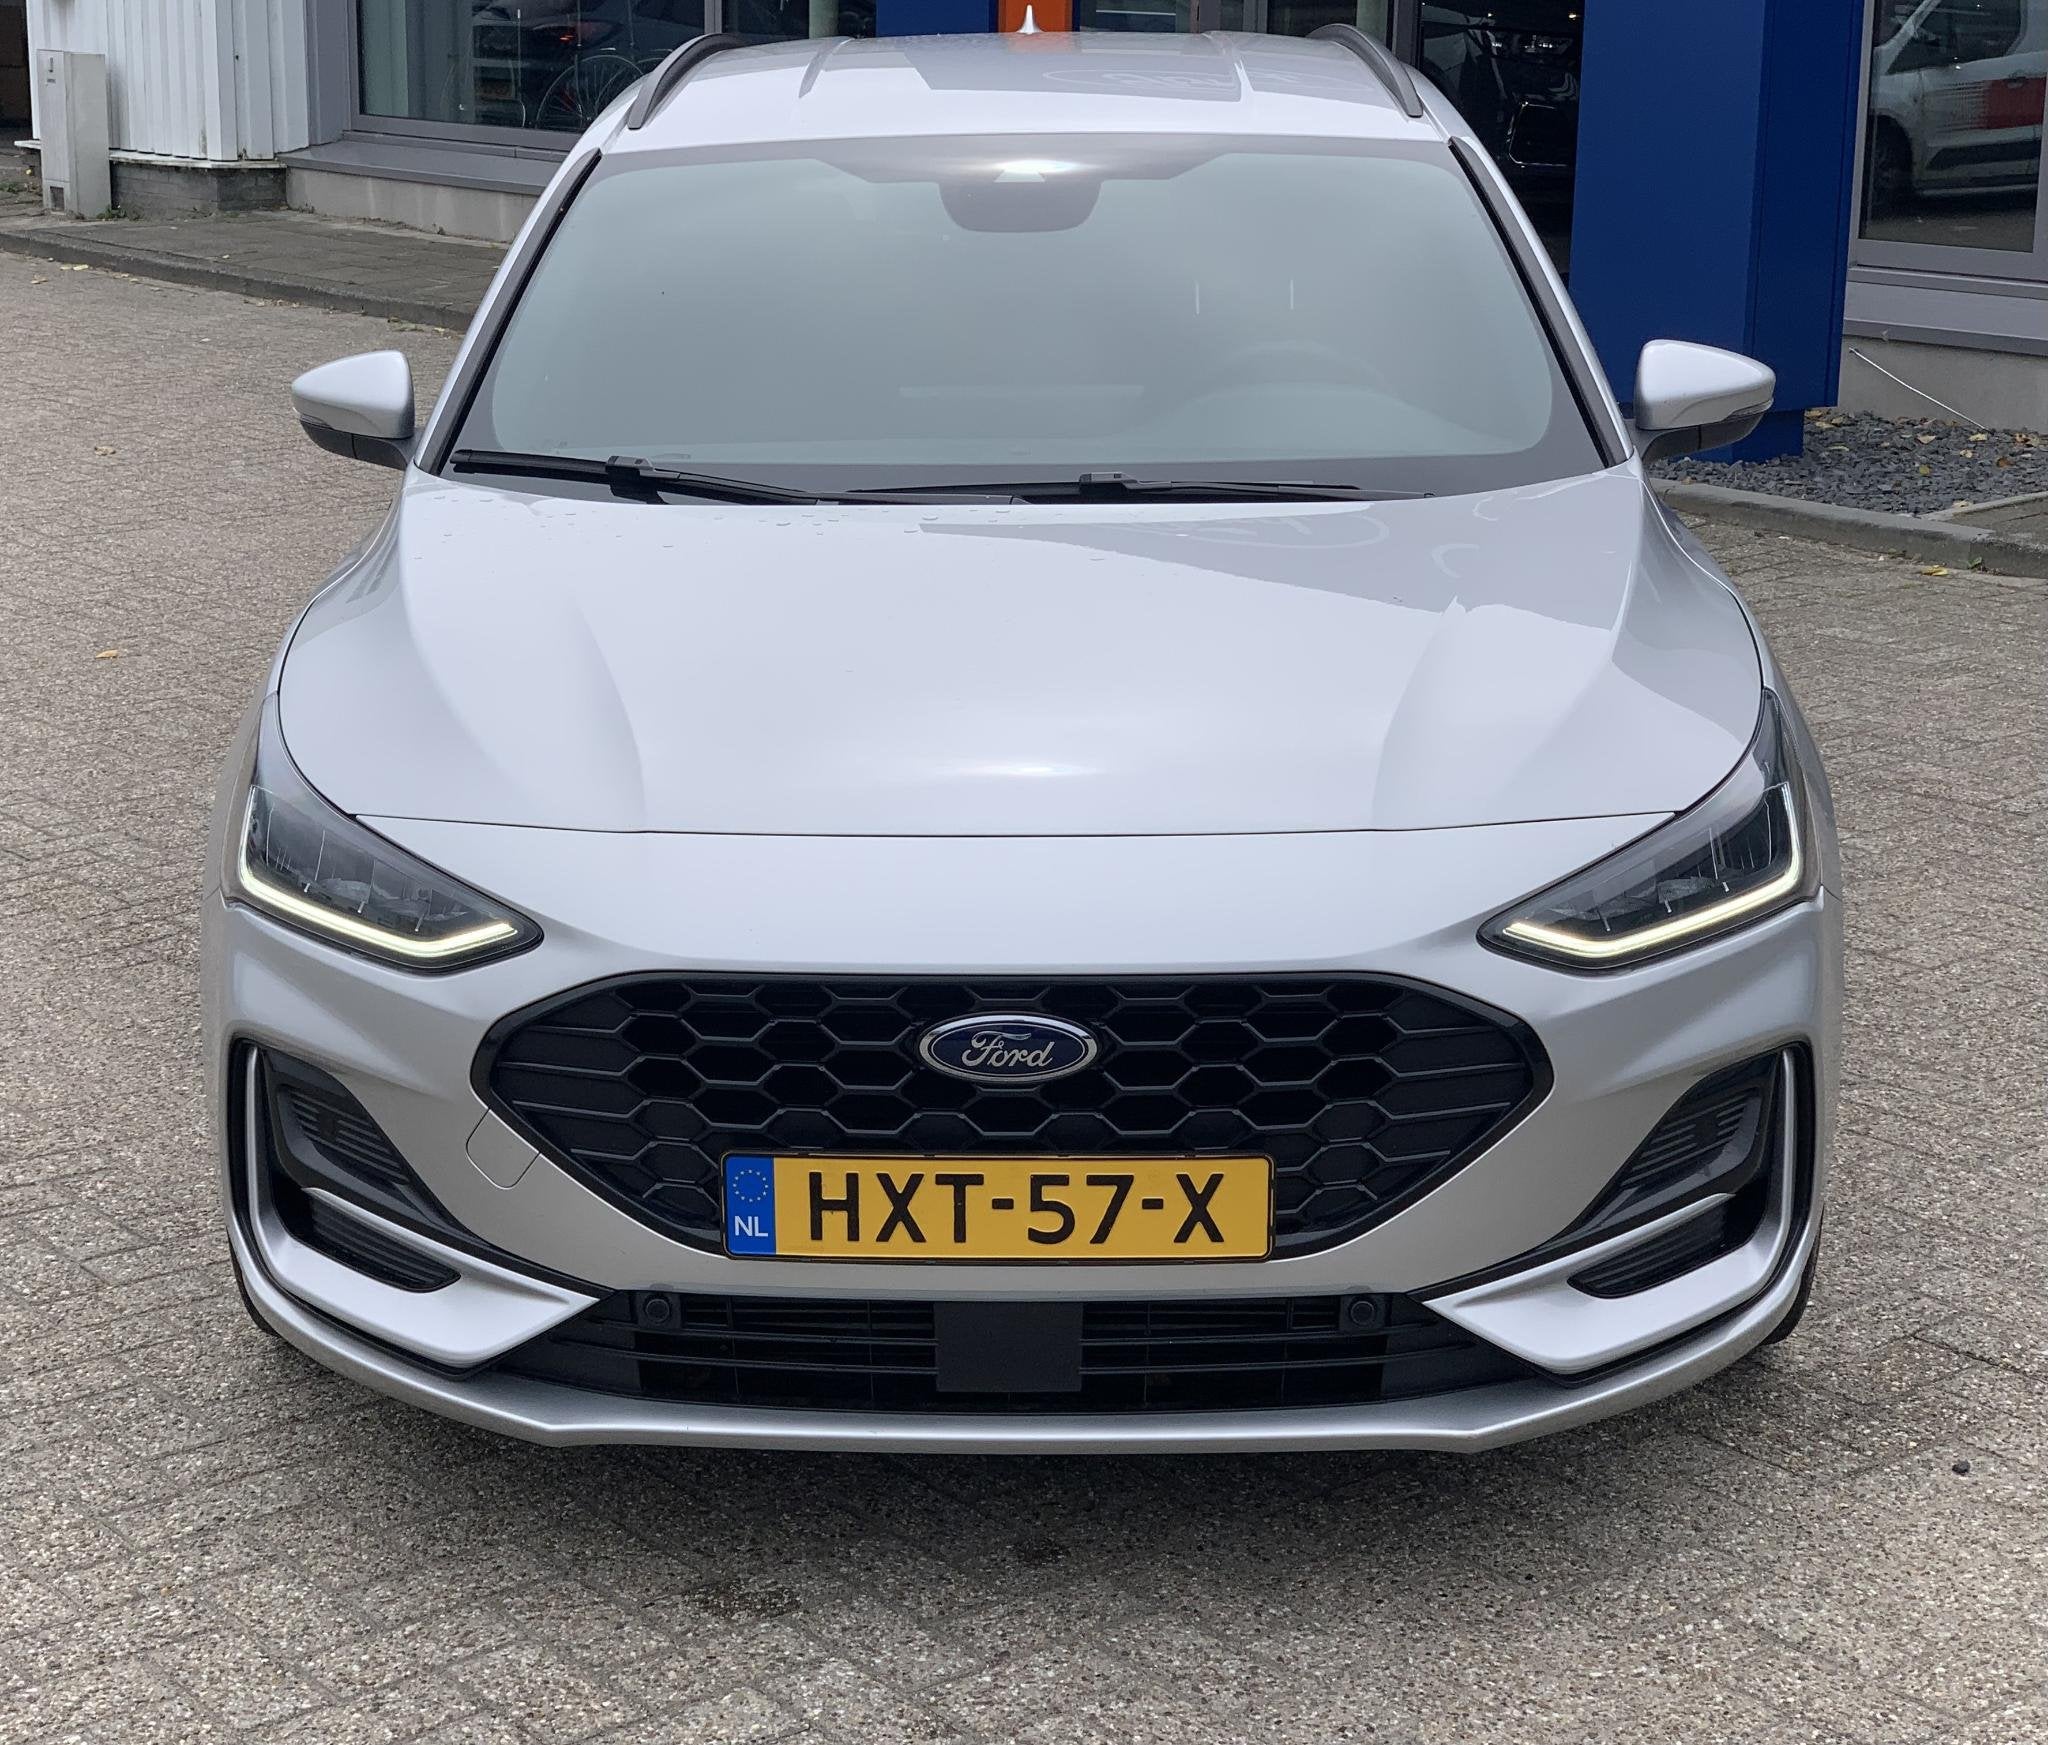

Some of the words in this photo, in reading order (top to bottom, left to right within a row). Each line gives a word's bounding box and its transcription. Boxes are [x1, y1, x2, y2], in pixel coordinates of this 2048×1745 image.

[961, 1029, 1055, 1069] Ford
[733, 1215, 769, 1239] NL
[808, 1171, 1225, 1245] HXT-57-X
